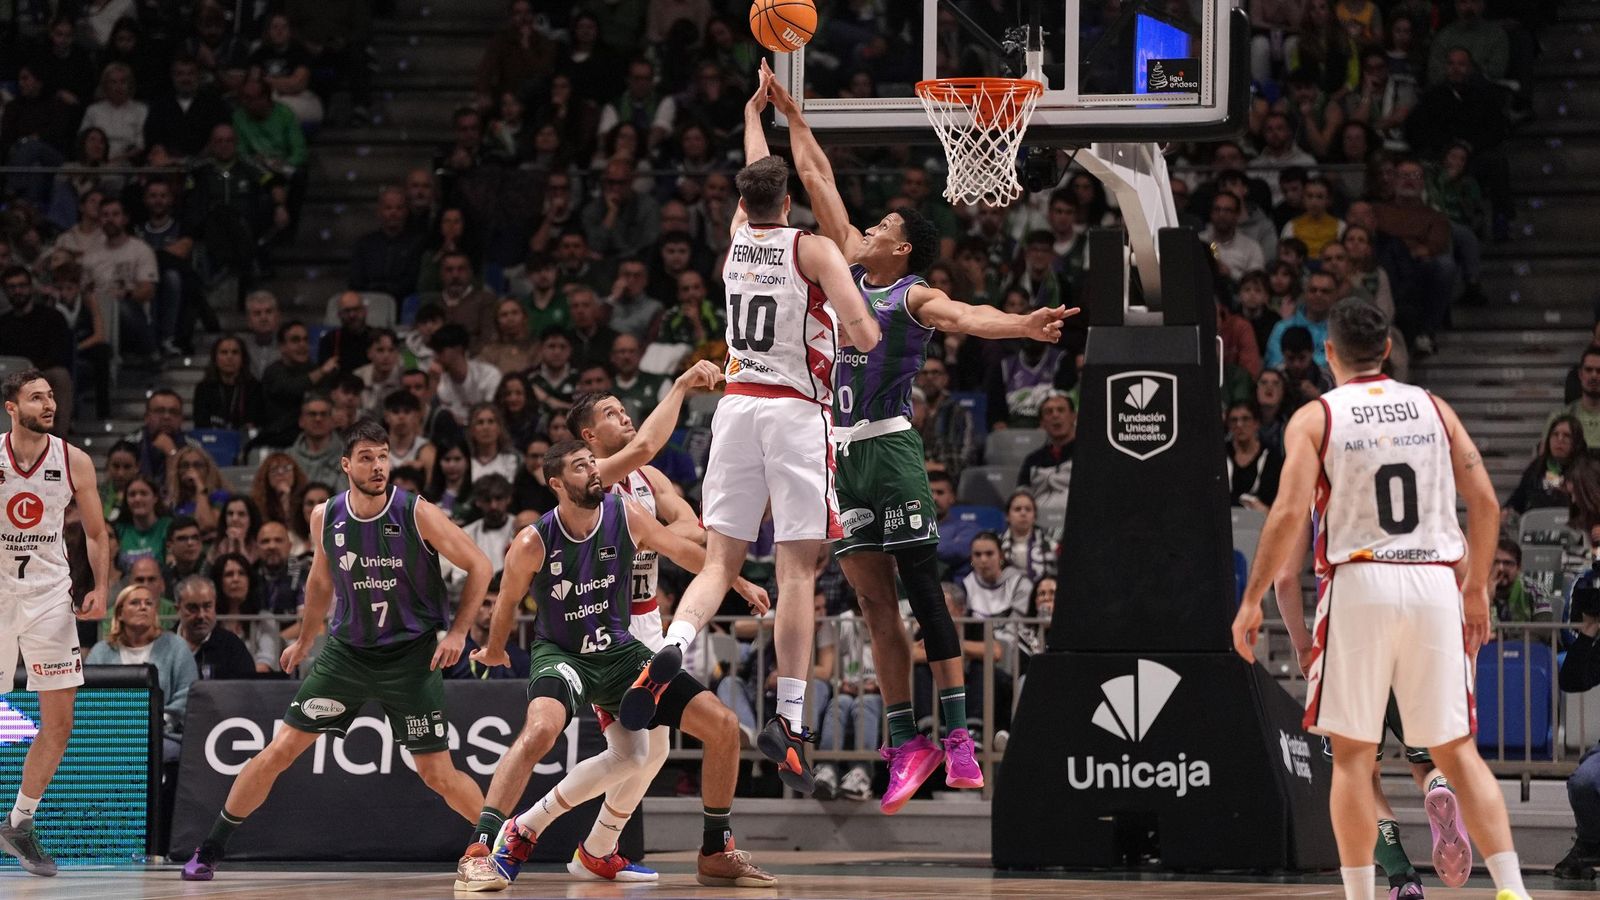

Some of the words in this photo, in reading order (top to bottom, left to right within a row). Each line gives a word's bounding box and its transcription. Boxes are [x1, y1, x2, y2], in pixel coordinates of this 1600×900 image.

[732, 244, 785, 266] FERNANDEZ
[728, 271, 738, 281] AIR
[729, 294, 778, 352] 10
[1118, 412, 1166, 422] Fundación
[1351, 401, 1420, 424] SPISSU
[1118, 432, 1167, 441] Baloncesto
[1125, 423, 1160, 433] Unicaja
[1344, 440, 1365, 452] AIR
[1374, 462, 1420, 536] 0
[14, 555, 31, 579] 7
[360, 556, 403, 569] Unicaja
[353, 576, 397, 591] málaga
[575, 574, 615, 596] Unicaja
[371, 601, 389, 628] 7
[564, 600, 609, 621] málaga
[580, 626, 612, 654] 45
[43, 661, 72, 670] Zaragoza
[1067, 752, 1211, 797] Unicaja
